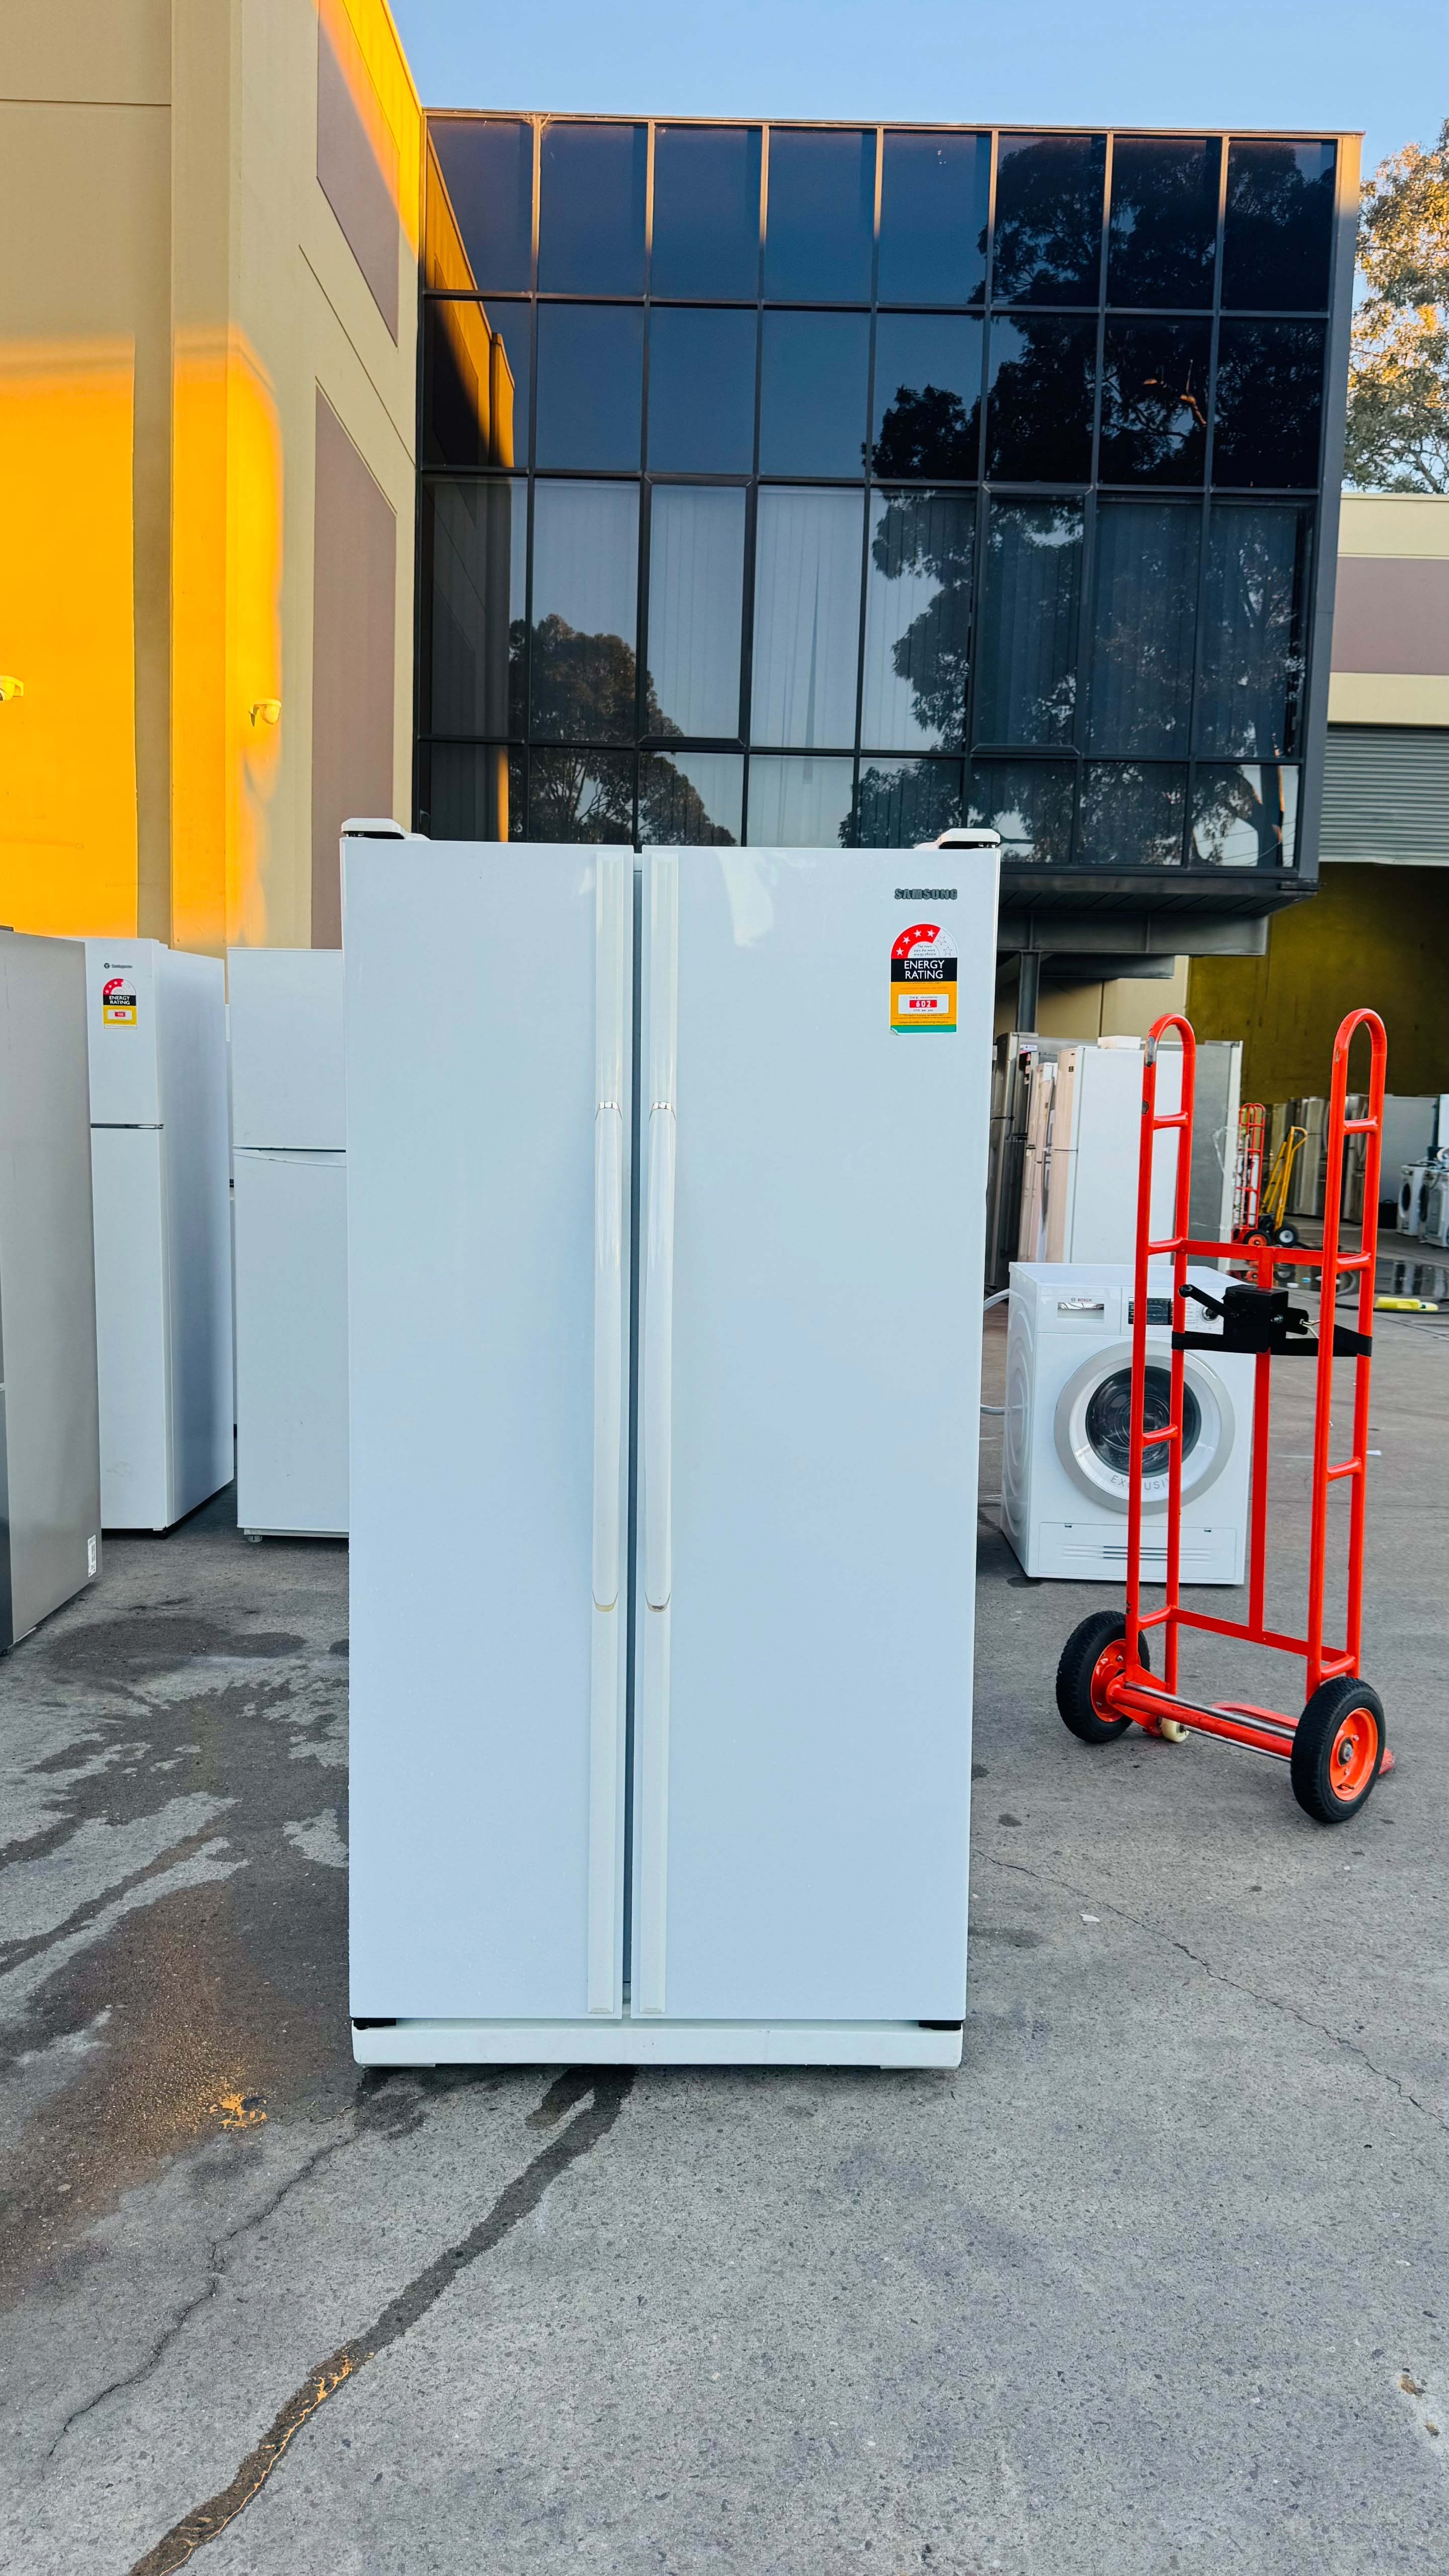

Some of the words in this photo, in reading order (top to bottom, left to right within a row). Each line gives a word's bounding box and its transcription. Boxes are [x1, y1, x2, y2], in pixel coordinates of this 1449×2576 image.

[895, 889, 957, 900] SAMSUNG
[904, 960, 945, 969] ENERGY
[906, 970, 943, 979] RATING
